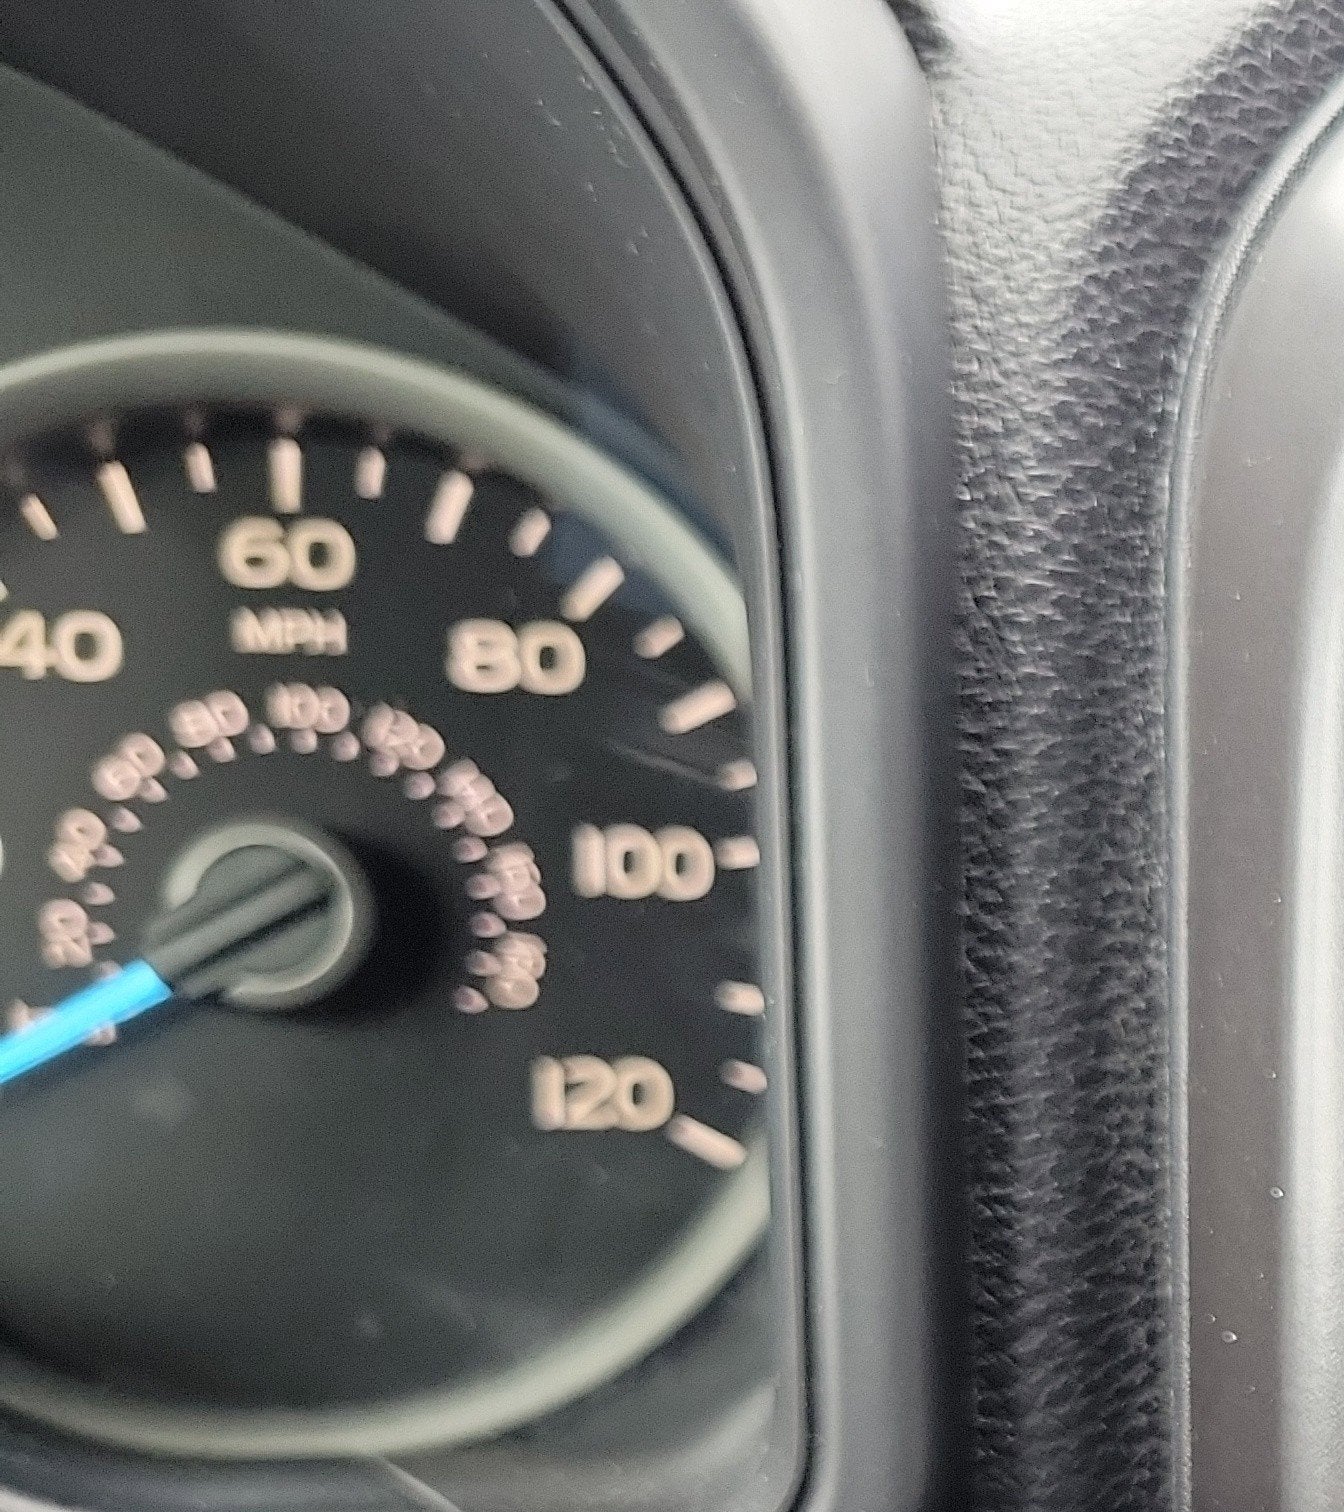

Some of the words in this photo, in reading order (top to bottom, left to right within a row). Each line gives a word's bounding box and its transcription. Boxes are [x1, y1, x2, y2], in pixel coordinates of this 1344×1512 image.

[219, 516, 357, 591] 60
[0, 607, 124, 684] 40
[230, 605, 348, 656] MPH
[446, 617, 587, 696] 80
[572, 822, 716, 902] 100
[530, 1055, 675, 1132] 120
